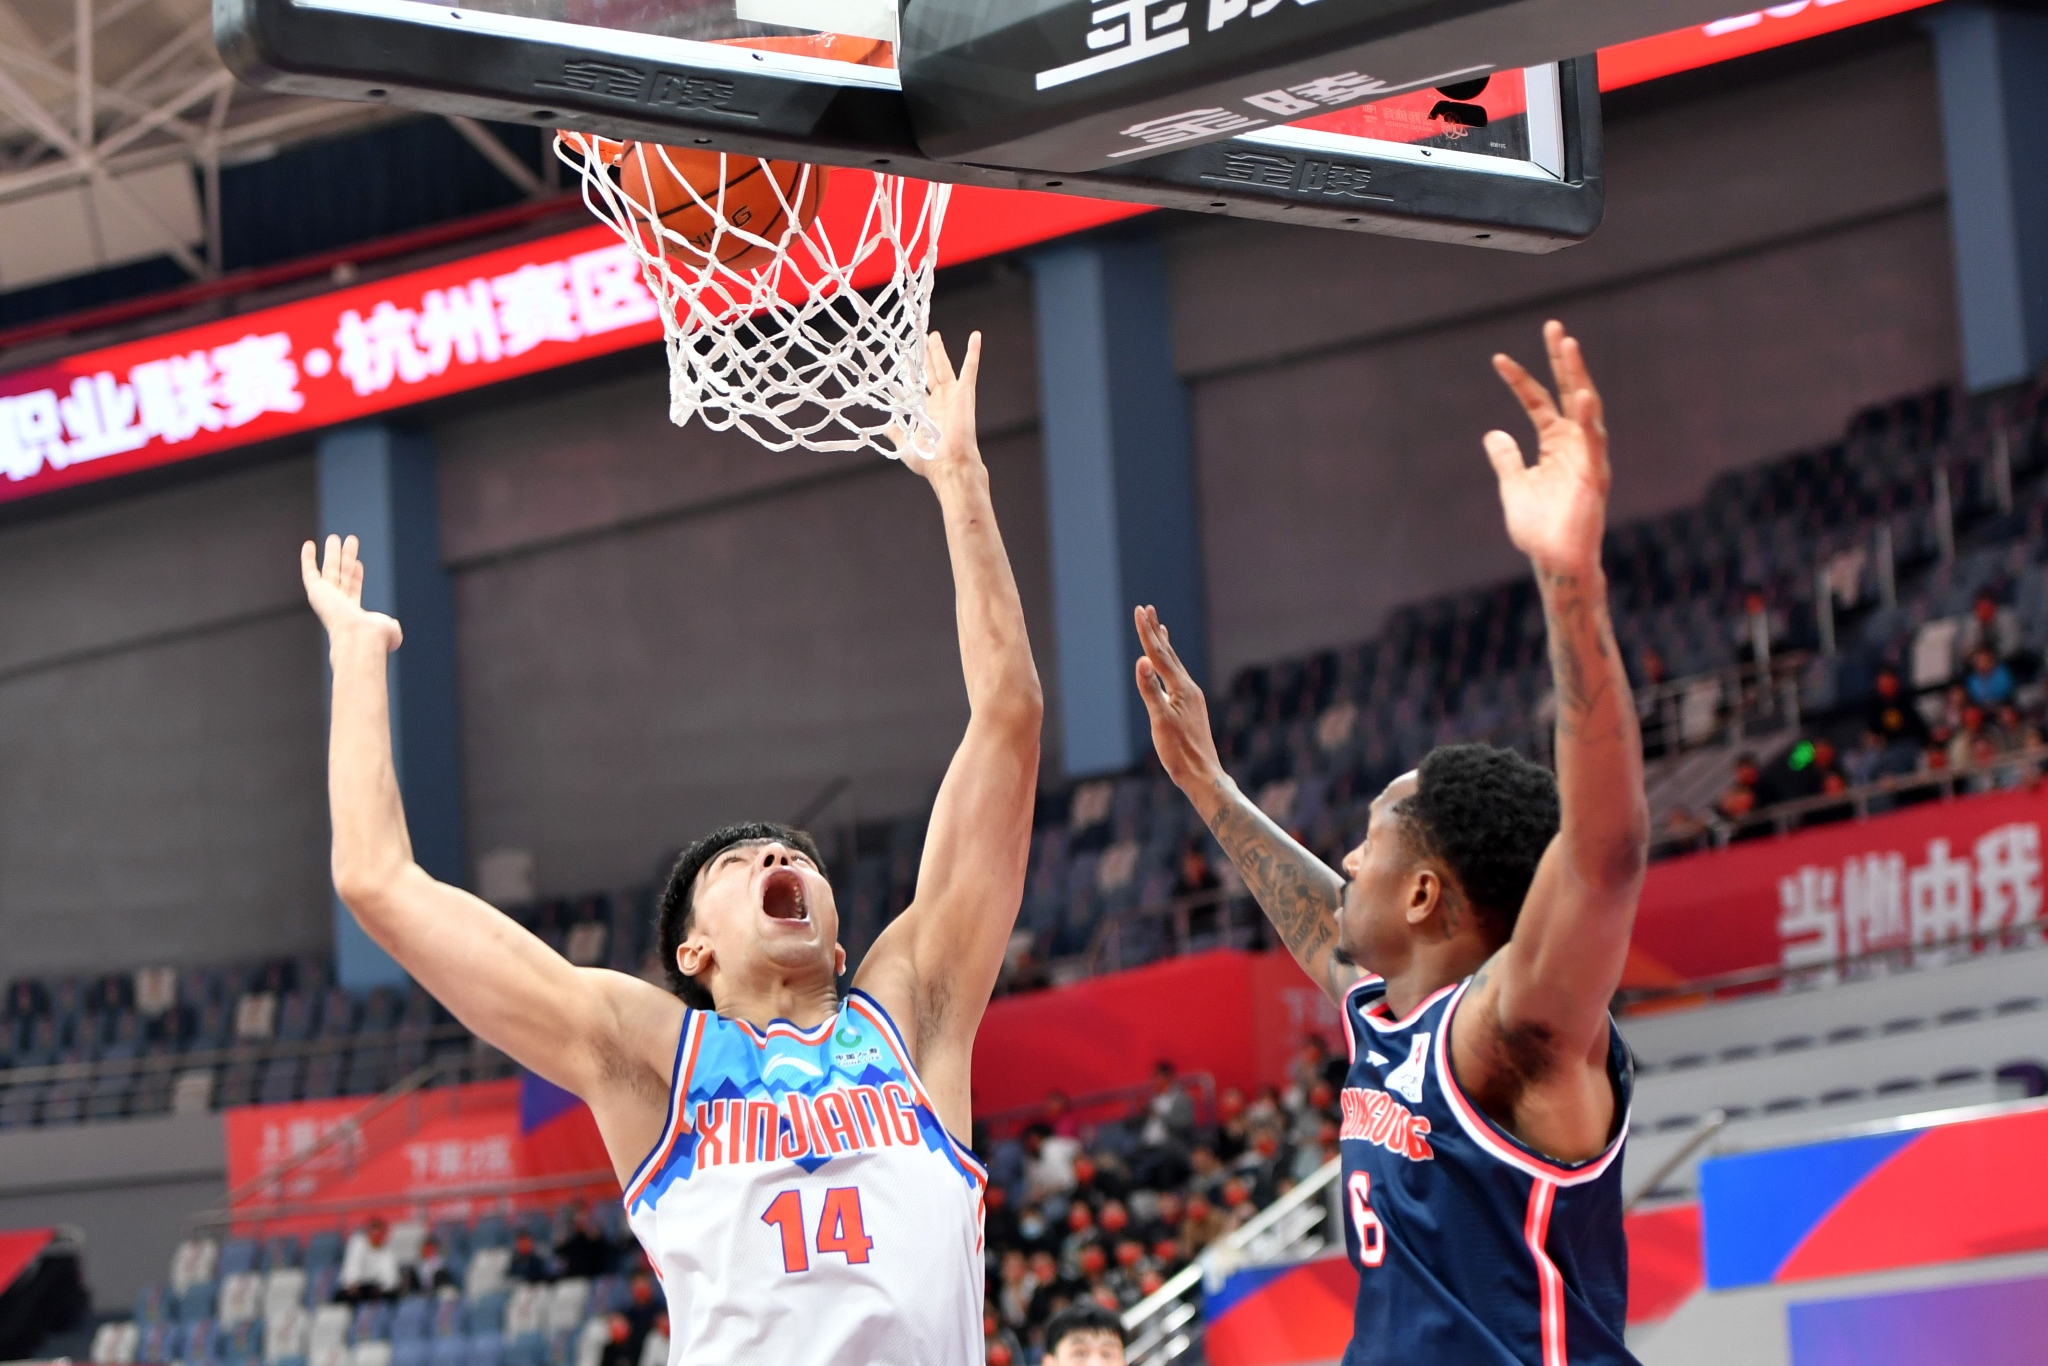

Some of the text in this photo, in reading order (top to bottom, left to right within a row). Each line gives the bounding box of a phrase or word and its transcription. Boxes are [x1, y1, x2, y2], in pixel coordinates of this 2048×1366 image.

[534, 58, 758, 119] 金陵
[1201, 150, 1394, 203] 金陵
[696, 1082, 922, 1170] XINJIANG
[760, 1186, 873, 1273] 14
[1348, 1171, 1386, 1267] 6
